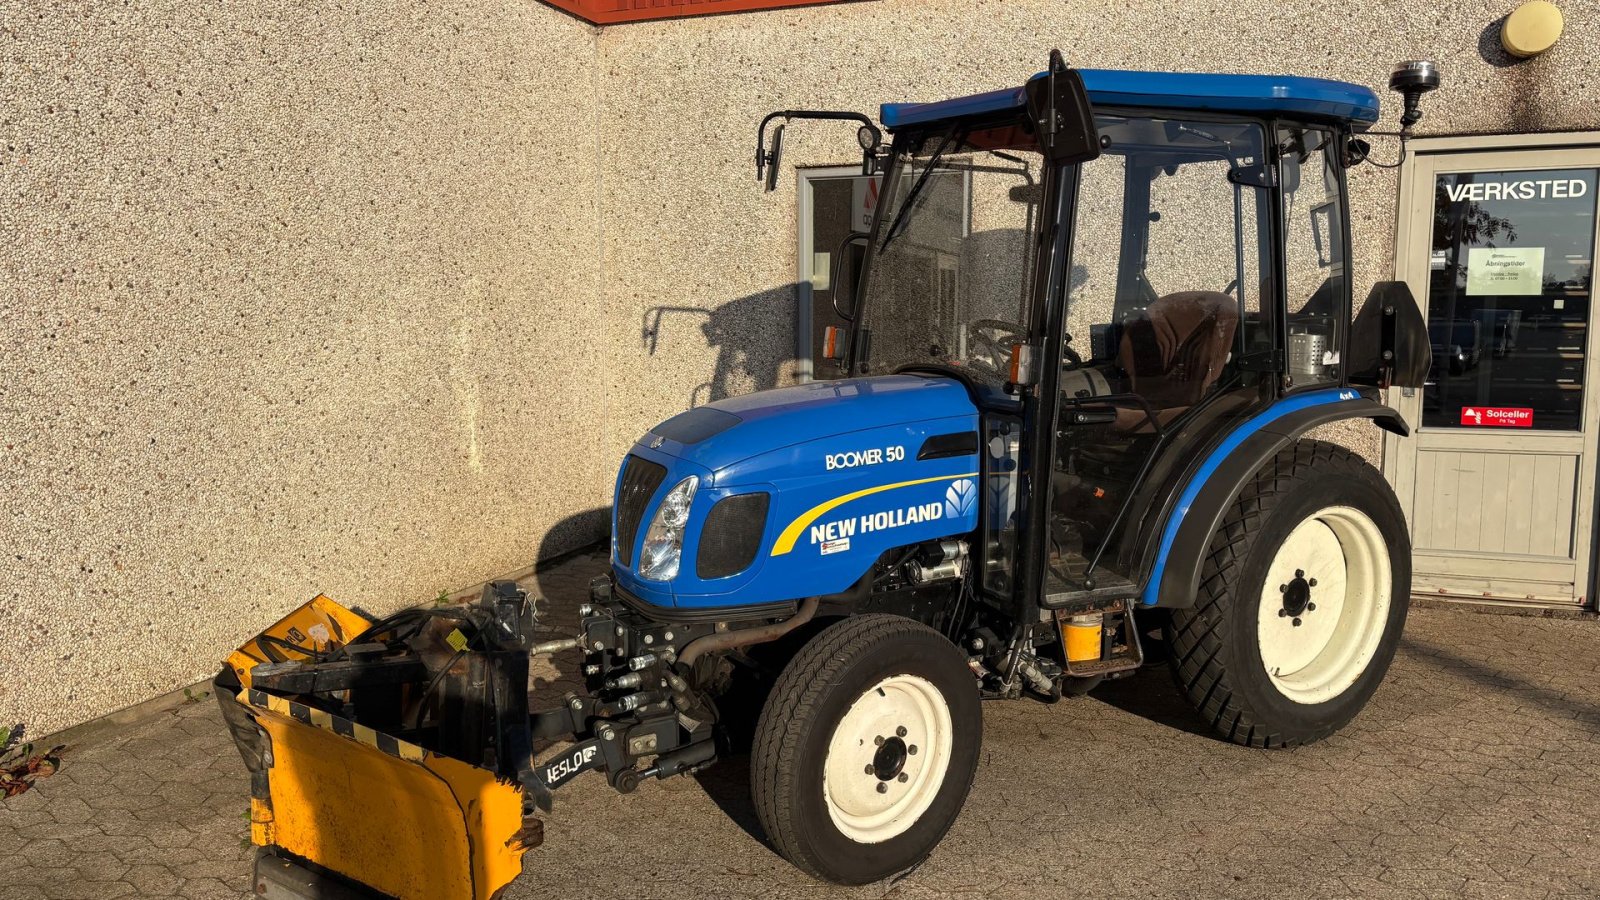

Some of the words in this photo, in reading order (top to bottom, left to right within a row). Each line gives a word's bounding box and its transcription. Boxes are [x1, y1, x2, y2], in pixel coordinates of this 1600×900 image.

[1446, 179, 1587, 202] VÆRKSTED
[1339, 391, 1354, 400] 4x4
[1486, 409, 1530, 419] Solceller
[825, 448, 883, 471] BOOMER
[885, 445, 905, 462] 50
[810, 517, 857, 545] NEW
[860, 502, 943, 534] HOLLAND
